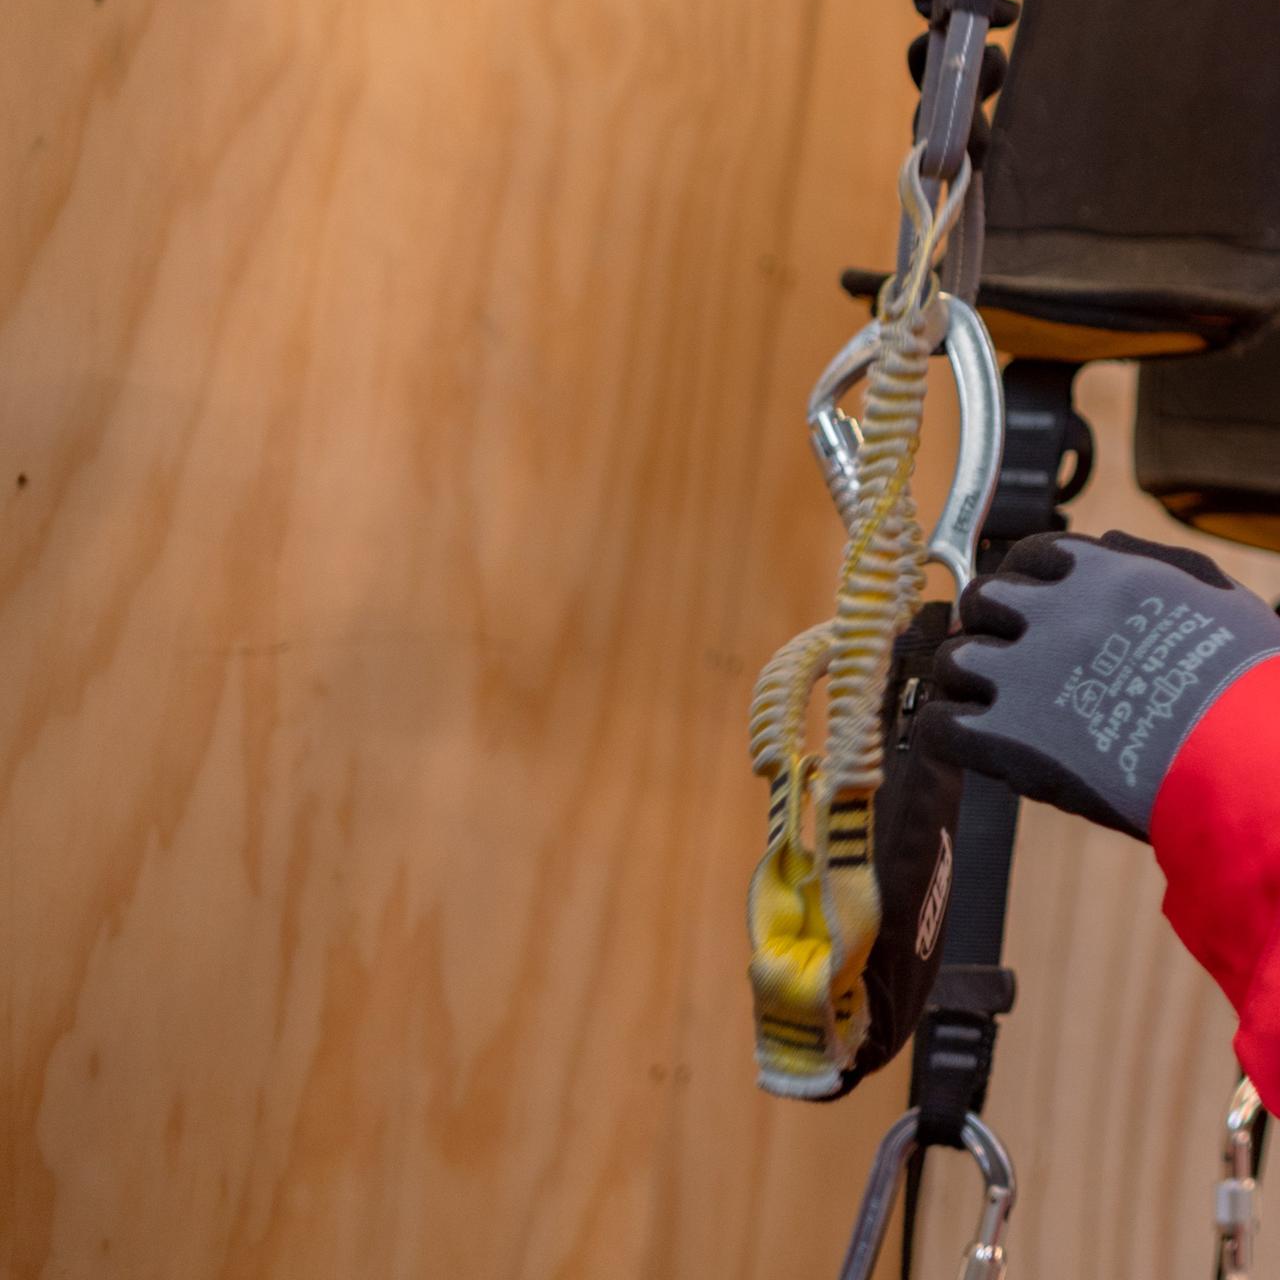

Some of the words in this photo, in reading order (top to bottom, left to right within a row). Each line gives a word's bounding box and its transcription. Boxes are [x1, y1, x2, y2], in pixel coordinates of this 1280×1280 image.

[1141, 611, 1215, 672] Touch
[1126, 674, 1148, 696] &
[1096, 700, 1132, 753] Grip
